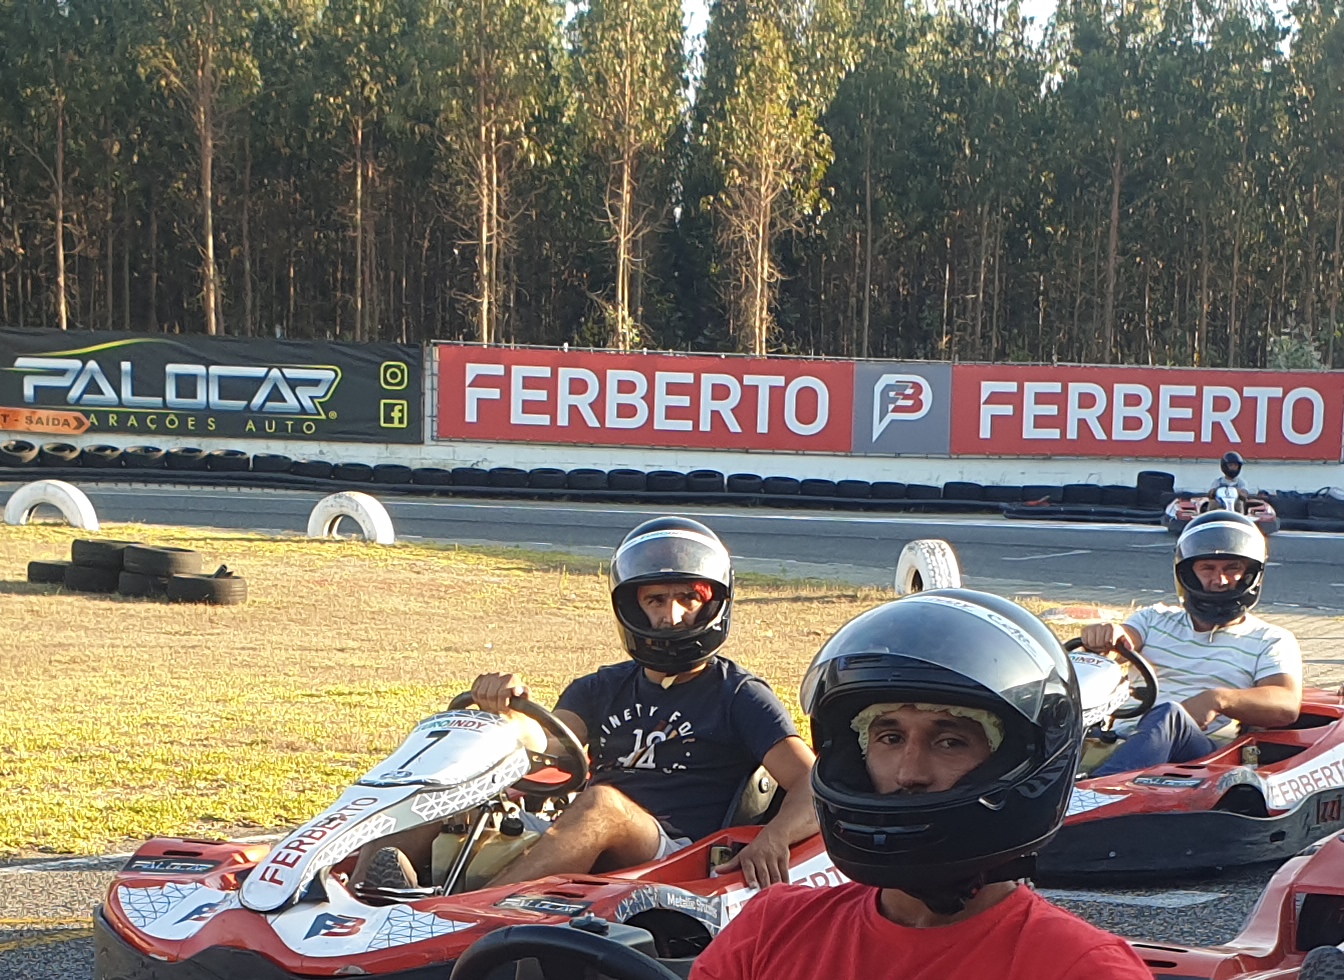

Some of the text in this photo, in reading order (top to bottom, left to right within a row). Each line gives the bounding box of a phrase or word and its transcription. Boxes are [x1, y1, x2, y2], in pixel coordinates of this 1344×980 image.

[13, 356, 340, 415] PALOCAR
[465, 363, 830, 436] FERBERTO
[980, 381, 1325, 445] FERBERTO
[25, 413, 73, 429] SAÍDA
[88, 412, 316, 435] ARAÇÕES AUTO
[398, 730, 452, 770] 7
[260, 795, 378, 888] FERBERTO
